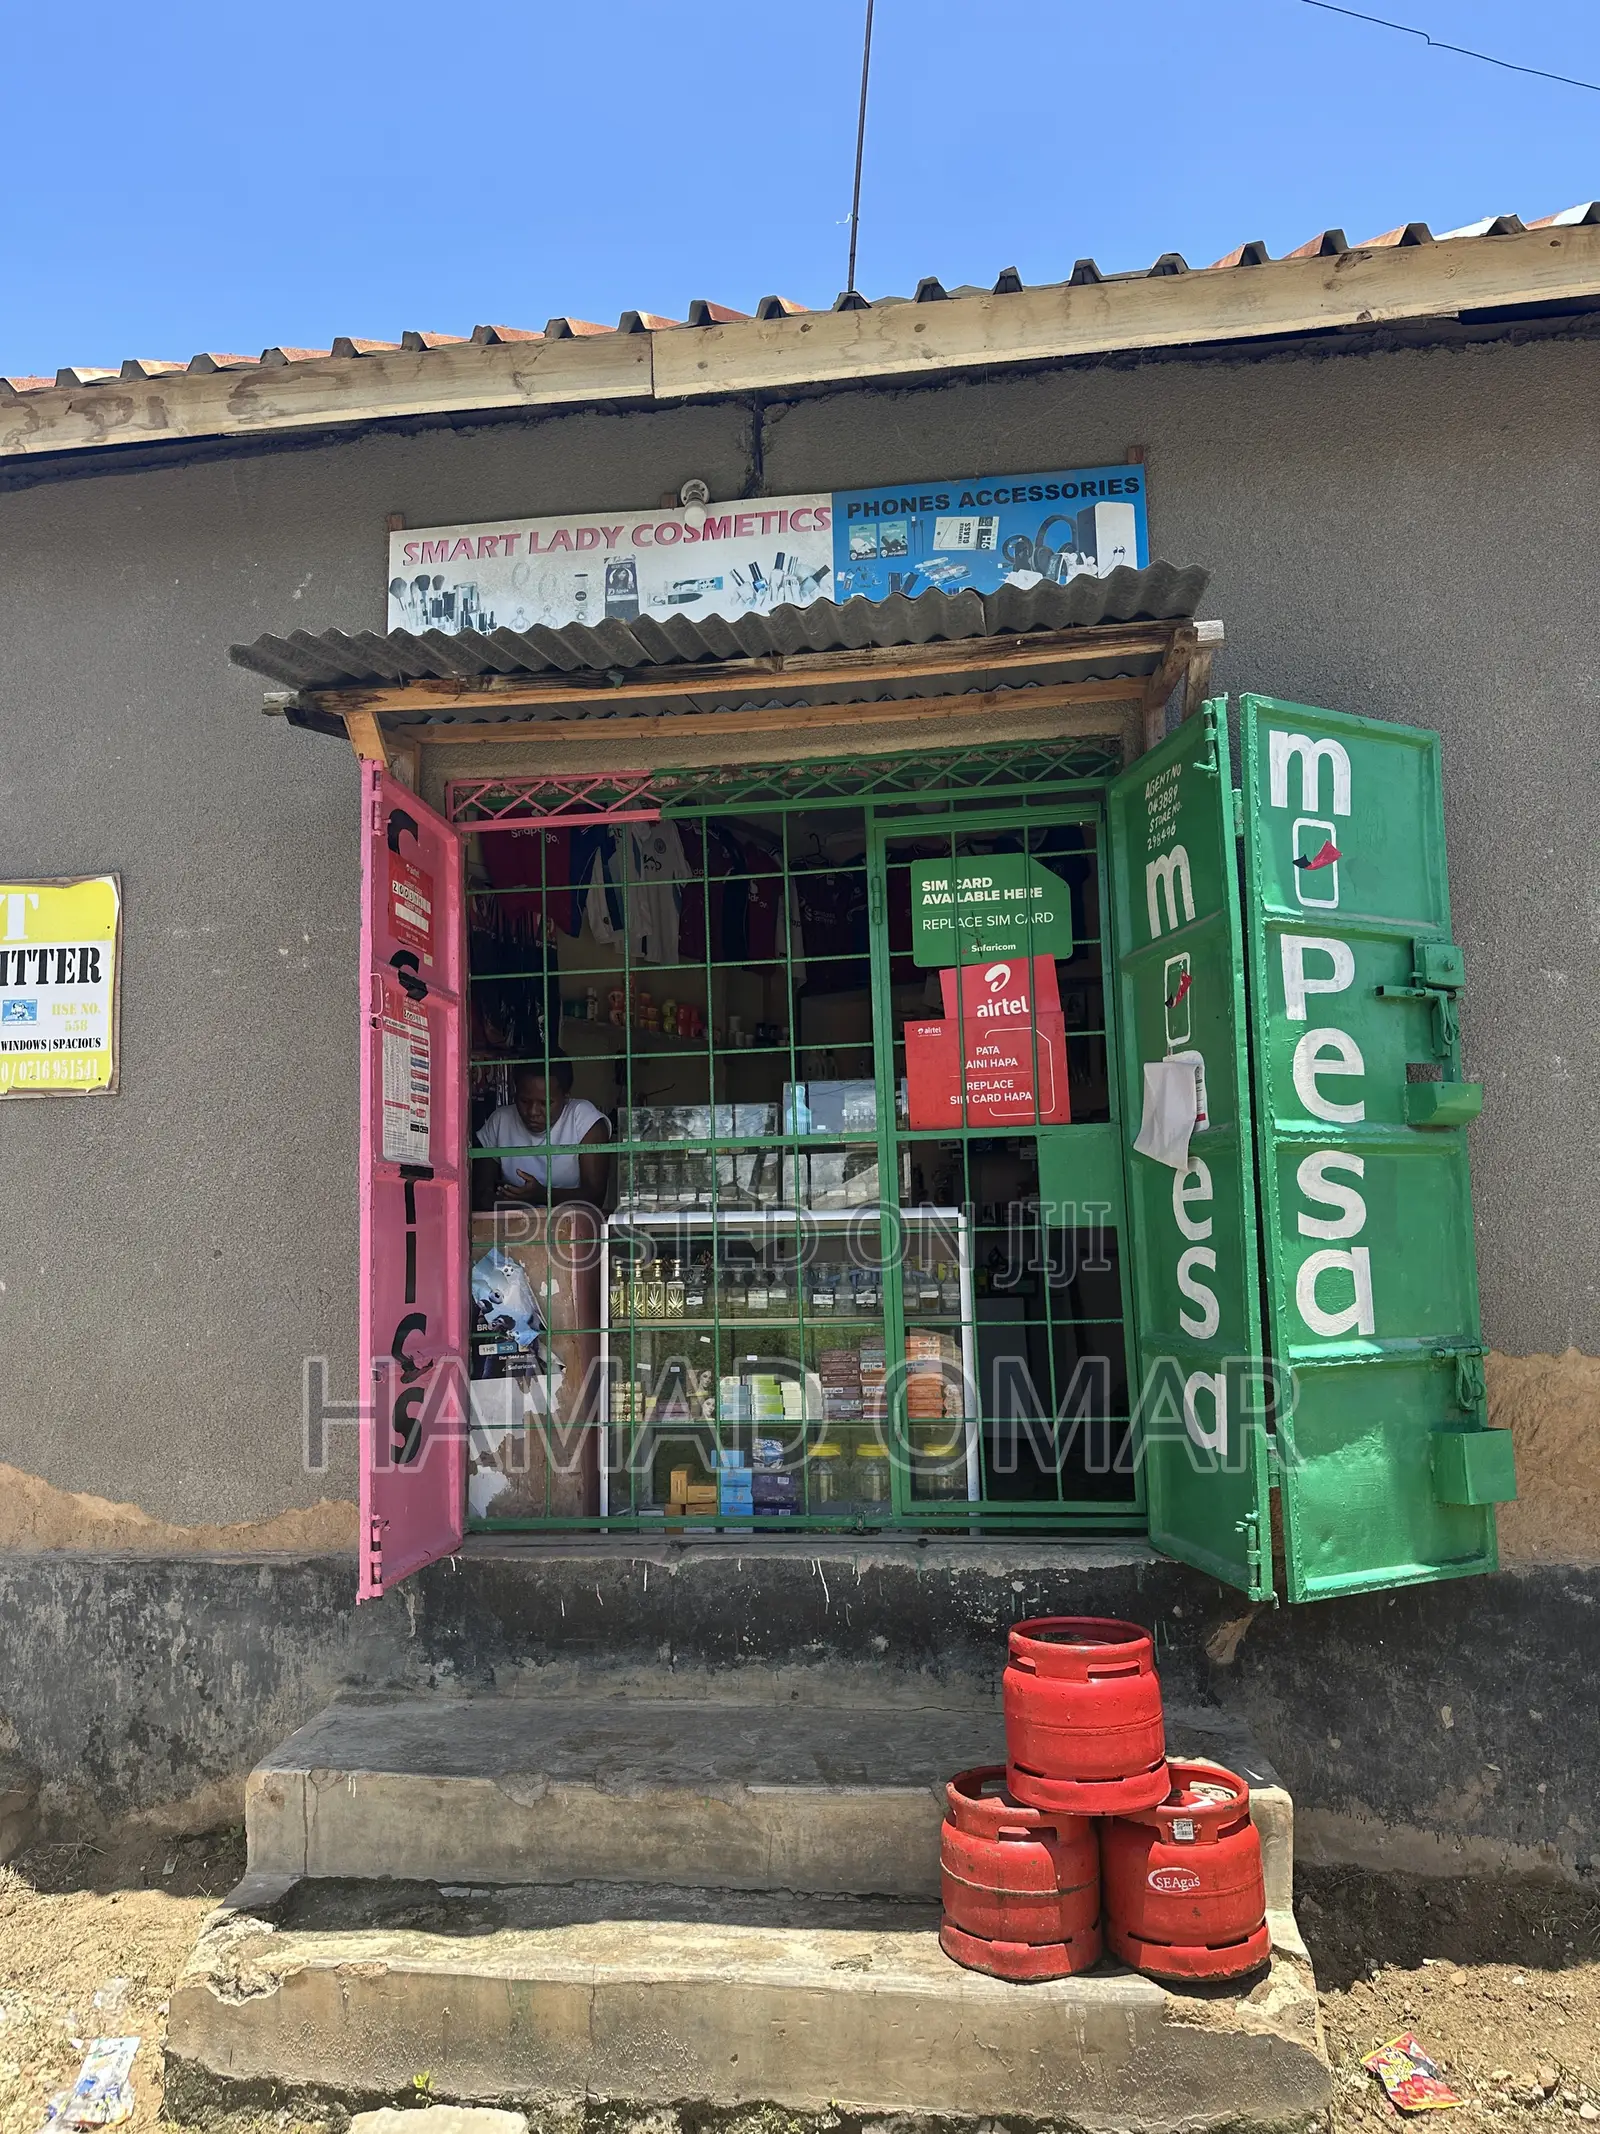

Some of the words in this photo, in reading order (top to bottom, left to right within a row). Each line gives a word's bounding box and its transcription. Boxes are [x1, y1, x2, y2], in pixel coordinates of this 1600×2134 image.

[847, 494, 950, 519] PHONES
[958, 476, 1140, 509] ACCESSORIES
[403, 533, 521, 566] SMART
[528, 525, 625, 555] LADY
[631, 506, 832, 548] COSMETICS
[963, 523, 971, 544] GLASS
[981, 535, 992, 549] 9H
[1145, 769, 1171, 801] AGENT
[1149, 807, 1172, 833] STORE
[921, 879, 948, 892] SIM
[922, 890, 1000, 906] AVAILABLE
[1003, 887, 1043, 900] HERE
[922, 917, 983, 931] REPLACE
[986, 915, 1011, 927] SIM
[1014, 912, 1054, 925] CARD
[971, 943, 1017, 952] Safaricom
[52, 1003, 77, 1016] HSE
[81, 1002, 101, 1015] NO.
[976, 995, 1030, 1018] airtel
[924, 1026, 942, 1034] airtel
[0, 1040, 47, 1052] WINDOWS
[53, 1037, 101, 1050] SPACIOUS
[976, 1046, 1000, 1056] PATA
[965, 1060, 988, 1070] AINI
[990, 1058, 1018, 1069] HAPA
[966, 1080, 1014, 1091] REPLACE
[972, 1093, 1001, 1104] CARD
[1003, 1091, 1032, 1102] HAPA
[1156, 1875, 1201, 1891] SEAgas
